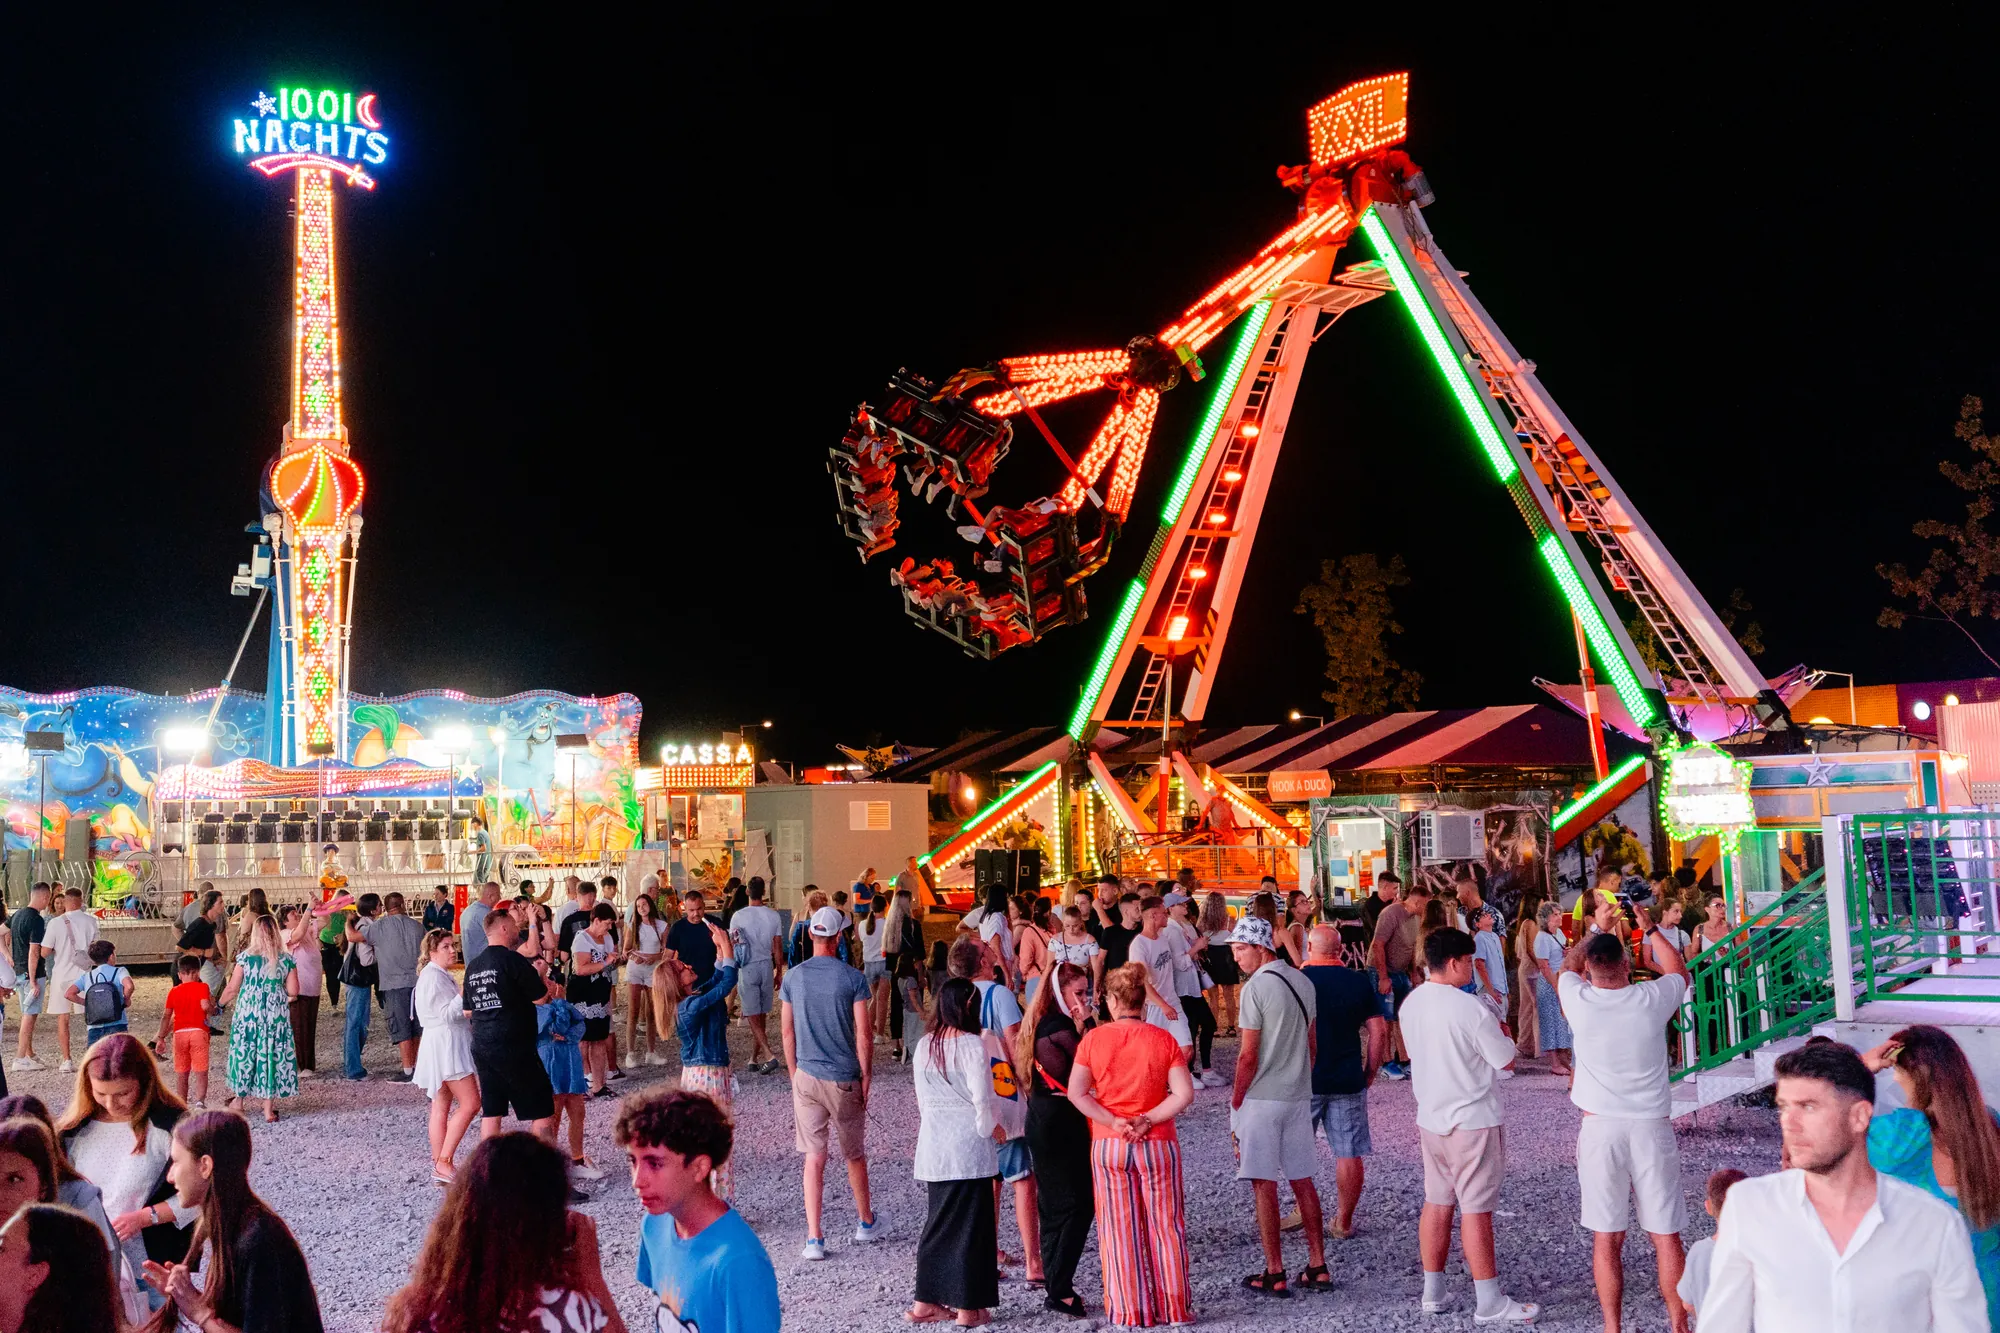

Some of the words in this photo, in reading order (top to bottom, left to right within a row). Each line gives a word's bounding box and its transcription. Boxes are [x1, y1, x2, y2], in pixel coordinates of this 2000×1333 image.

[280, 87, 352, 124] 1001
[233, 118, 389, 165] NACHTS
[1310, 88, 1407, 166] XXL
[661, 744, 753, 765] CASSA
[1272, 781, 1295, 793] HOOK
[1296, 781, 1303, 792] A
[1304, 779, 1327, 791] DUCK
